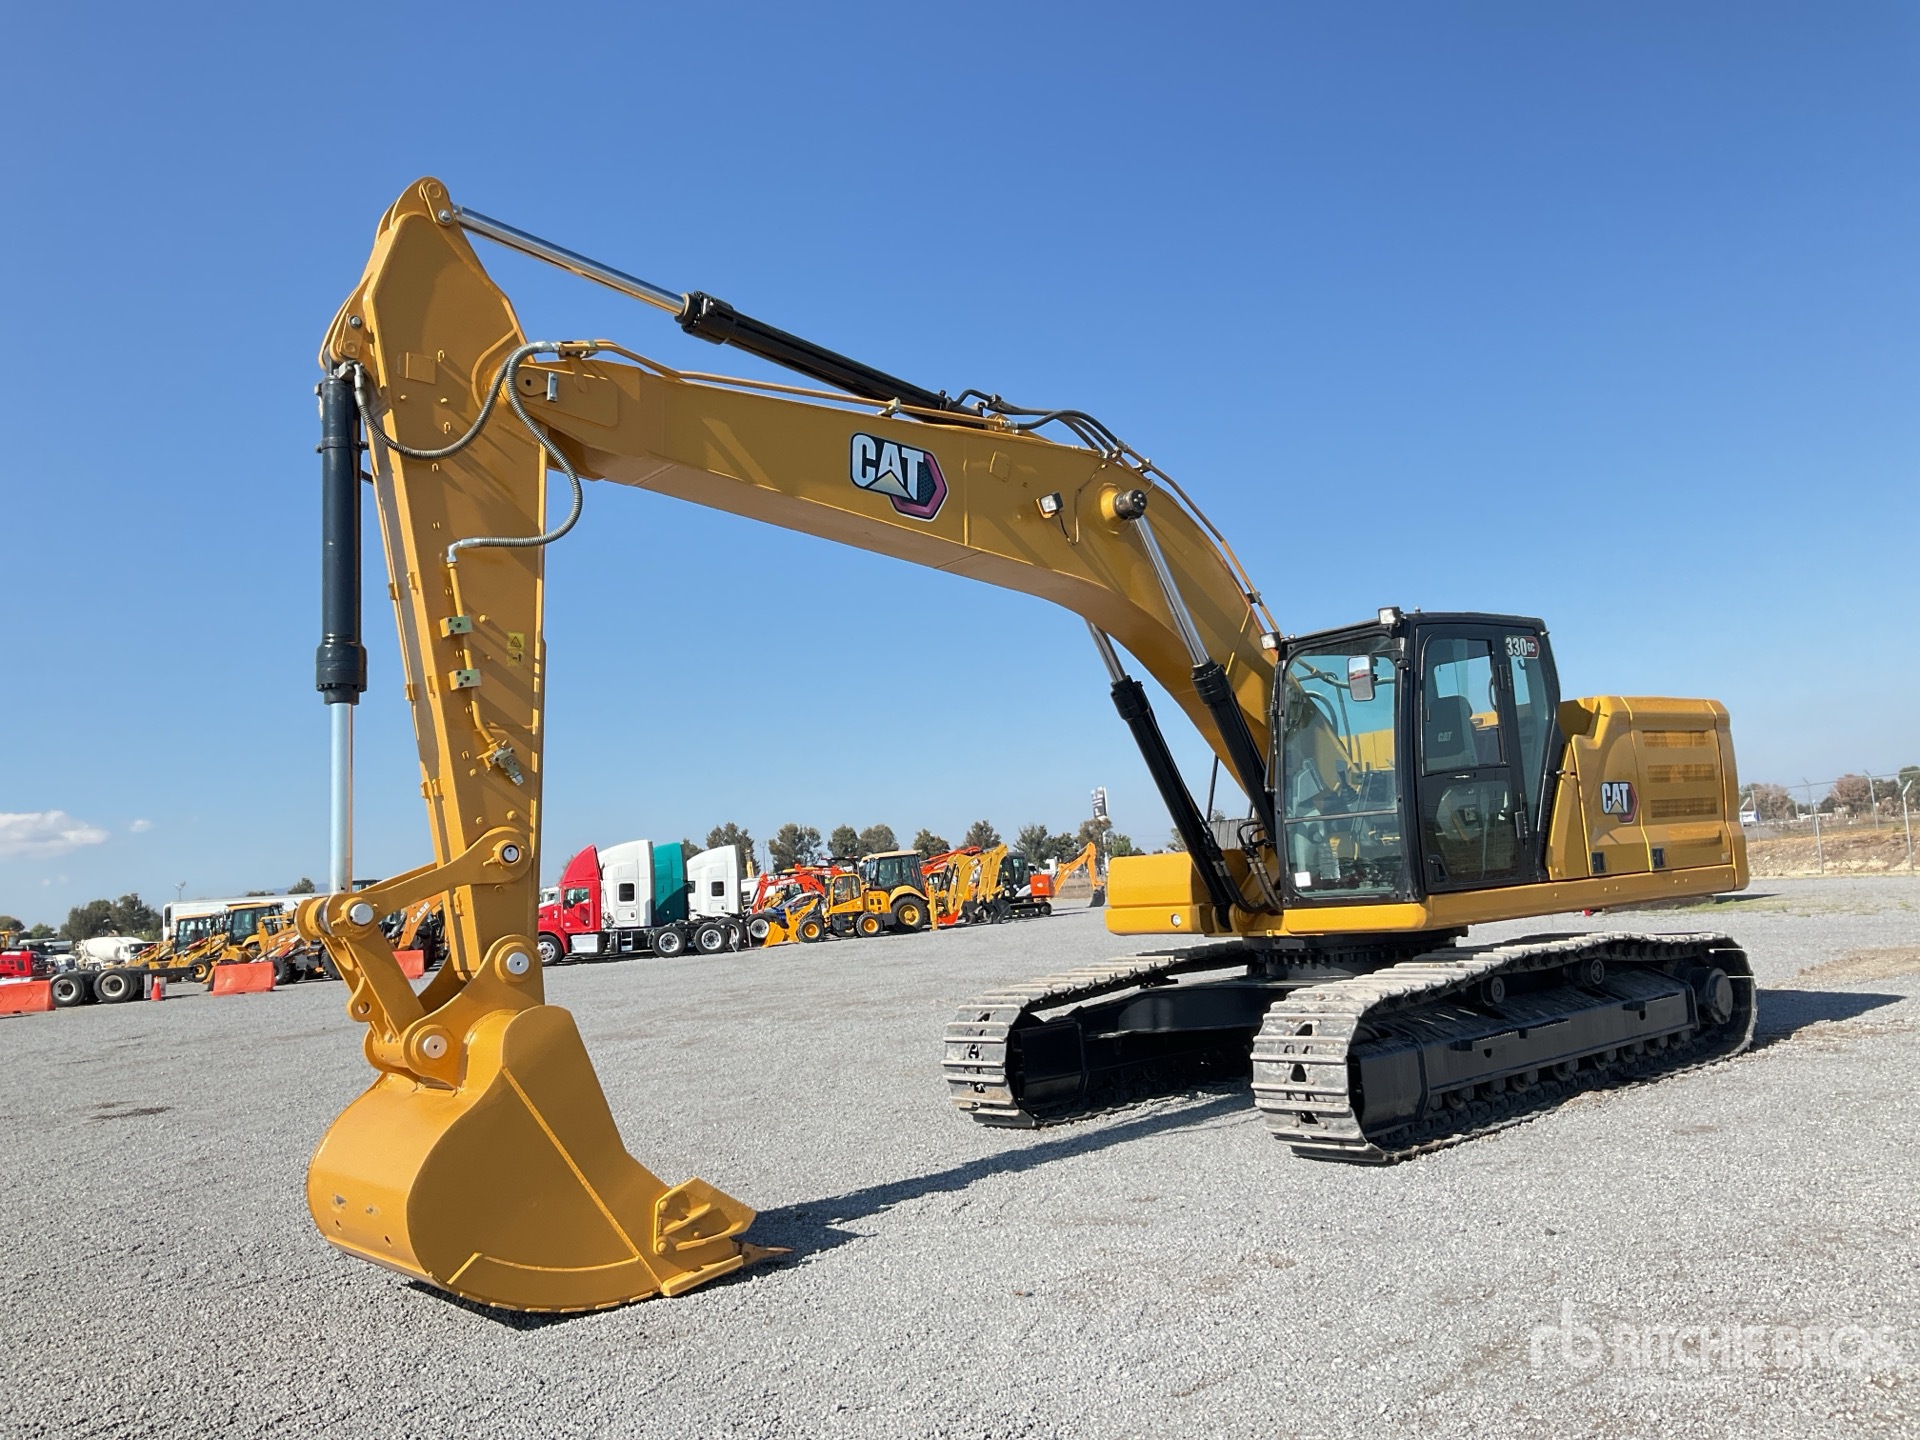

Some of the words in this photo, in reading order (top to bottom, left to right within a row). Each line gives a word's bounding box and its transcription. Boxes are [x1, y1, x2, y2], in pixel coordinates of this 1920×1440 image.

[851, 433, 924, 501] CAT
[1505, 636, 1528, 656] 330
[1527, 642, 1536, 653] GC
[1437, 731, 1453, 743] CAT
[1601, 783, 1629, 814] CAT
[410, 901, 431, 924] CASE
